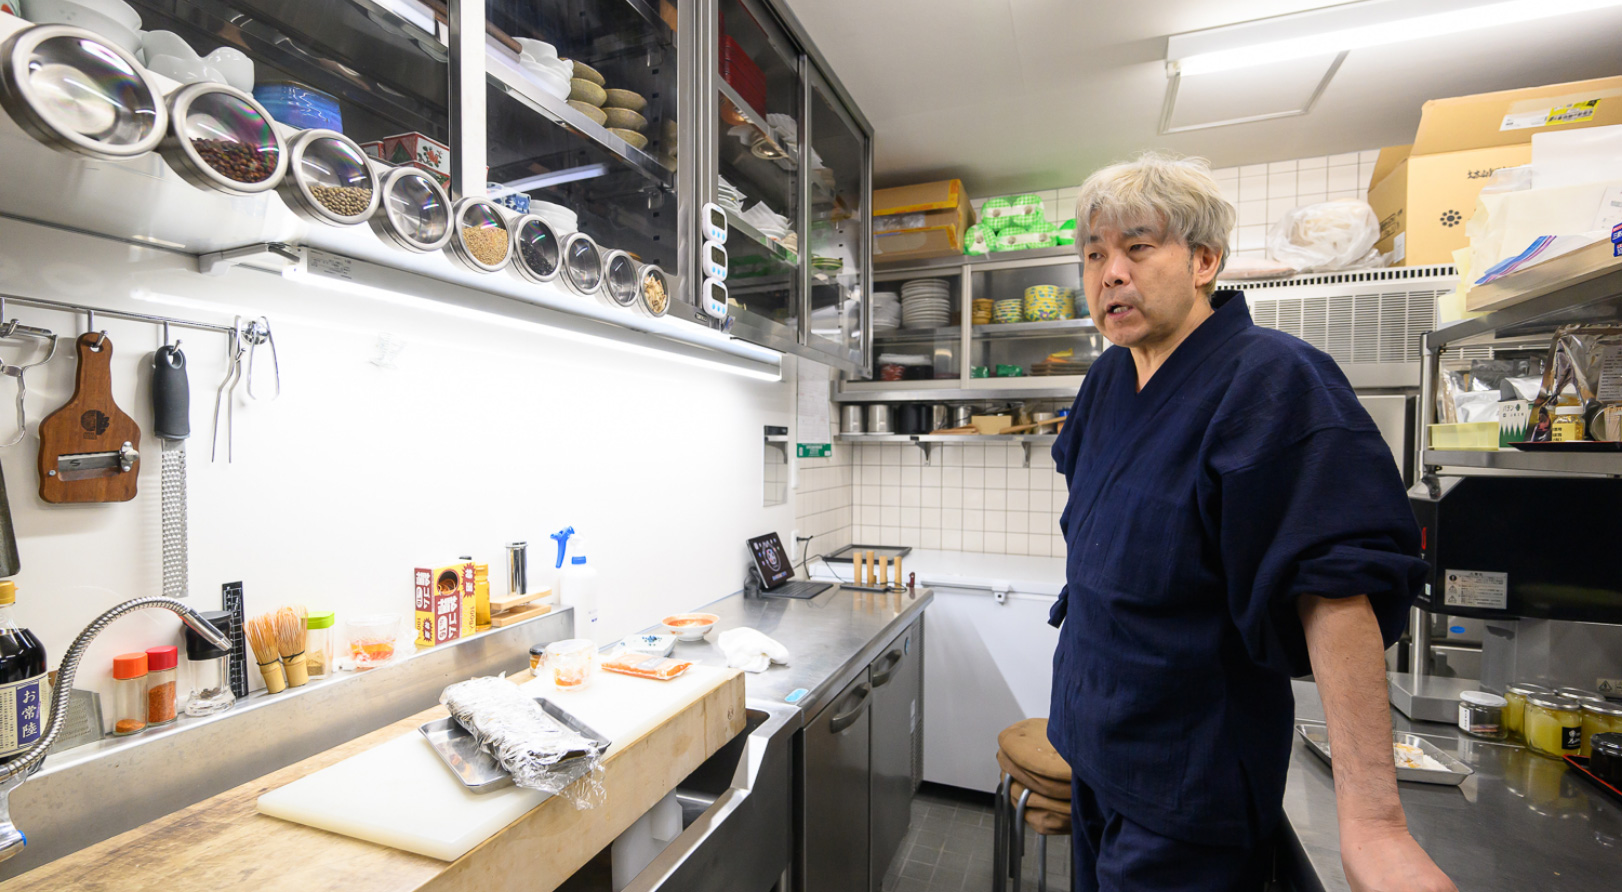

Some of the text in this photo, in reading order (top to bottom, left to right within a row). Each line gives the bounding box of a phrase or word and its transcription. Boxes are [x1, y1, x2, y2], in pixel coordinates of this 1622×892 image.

[416, 572, 431, 609] 輪ゴム
[438, 596, 458, 639] 輪ゴム
[21, 690, 37, 738] お常陸
